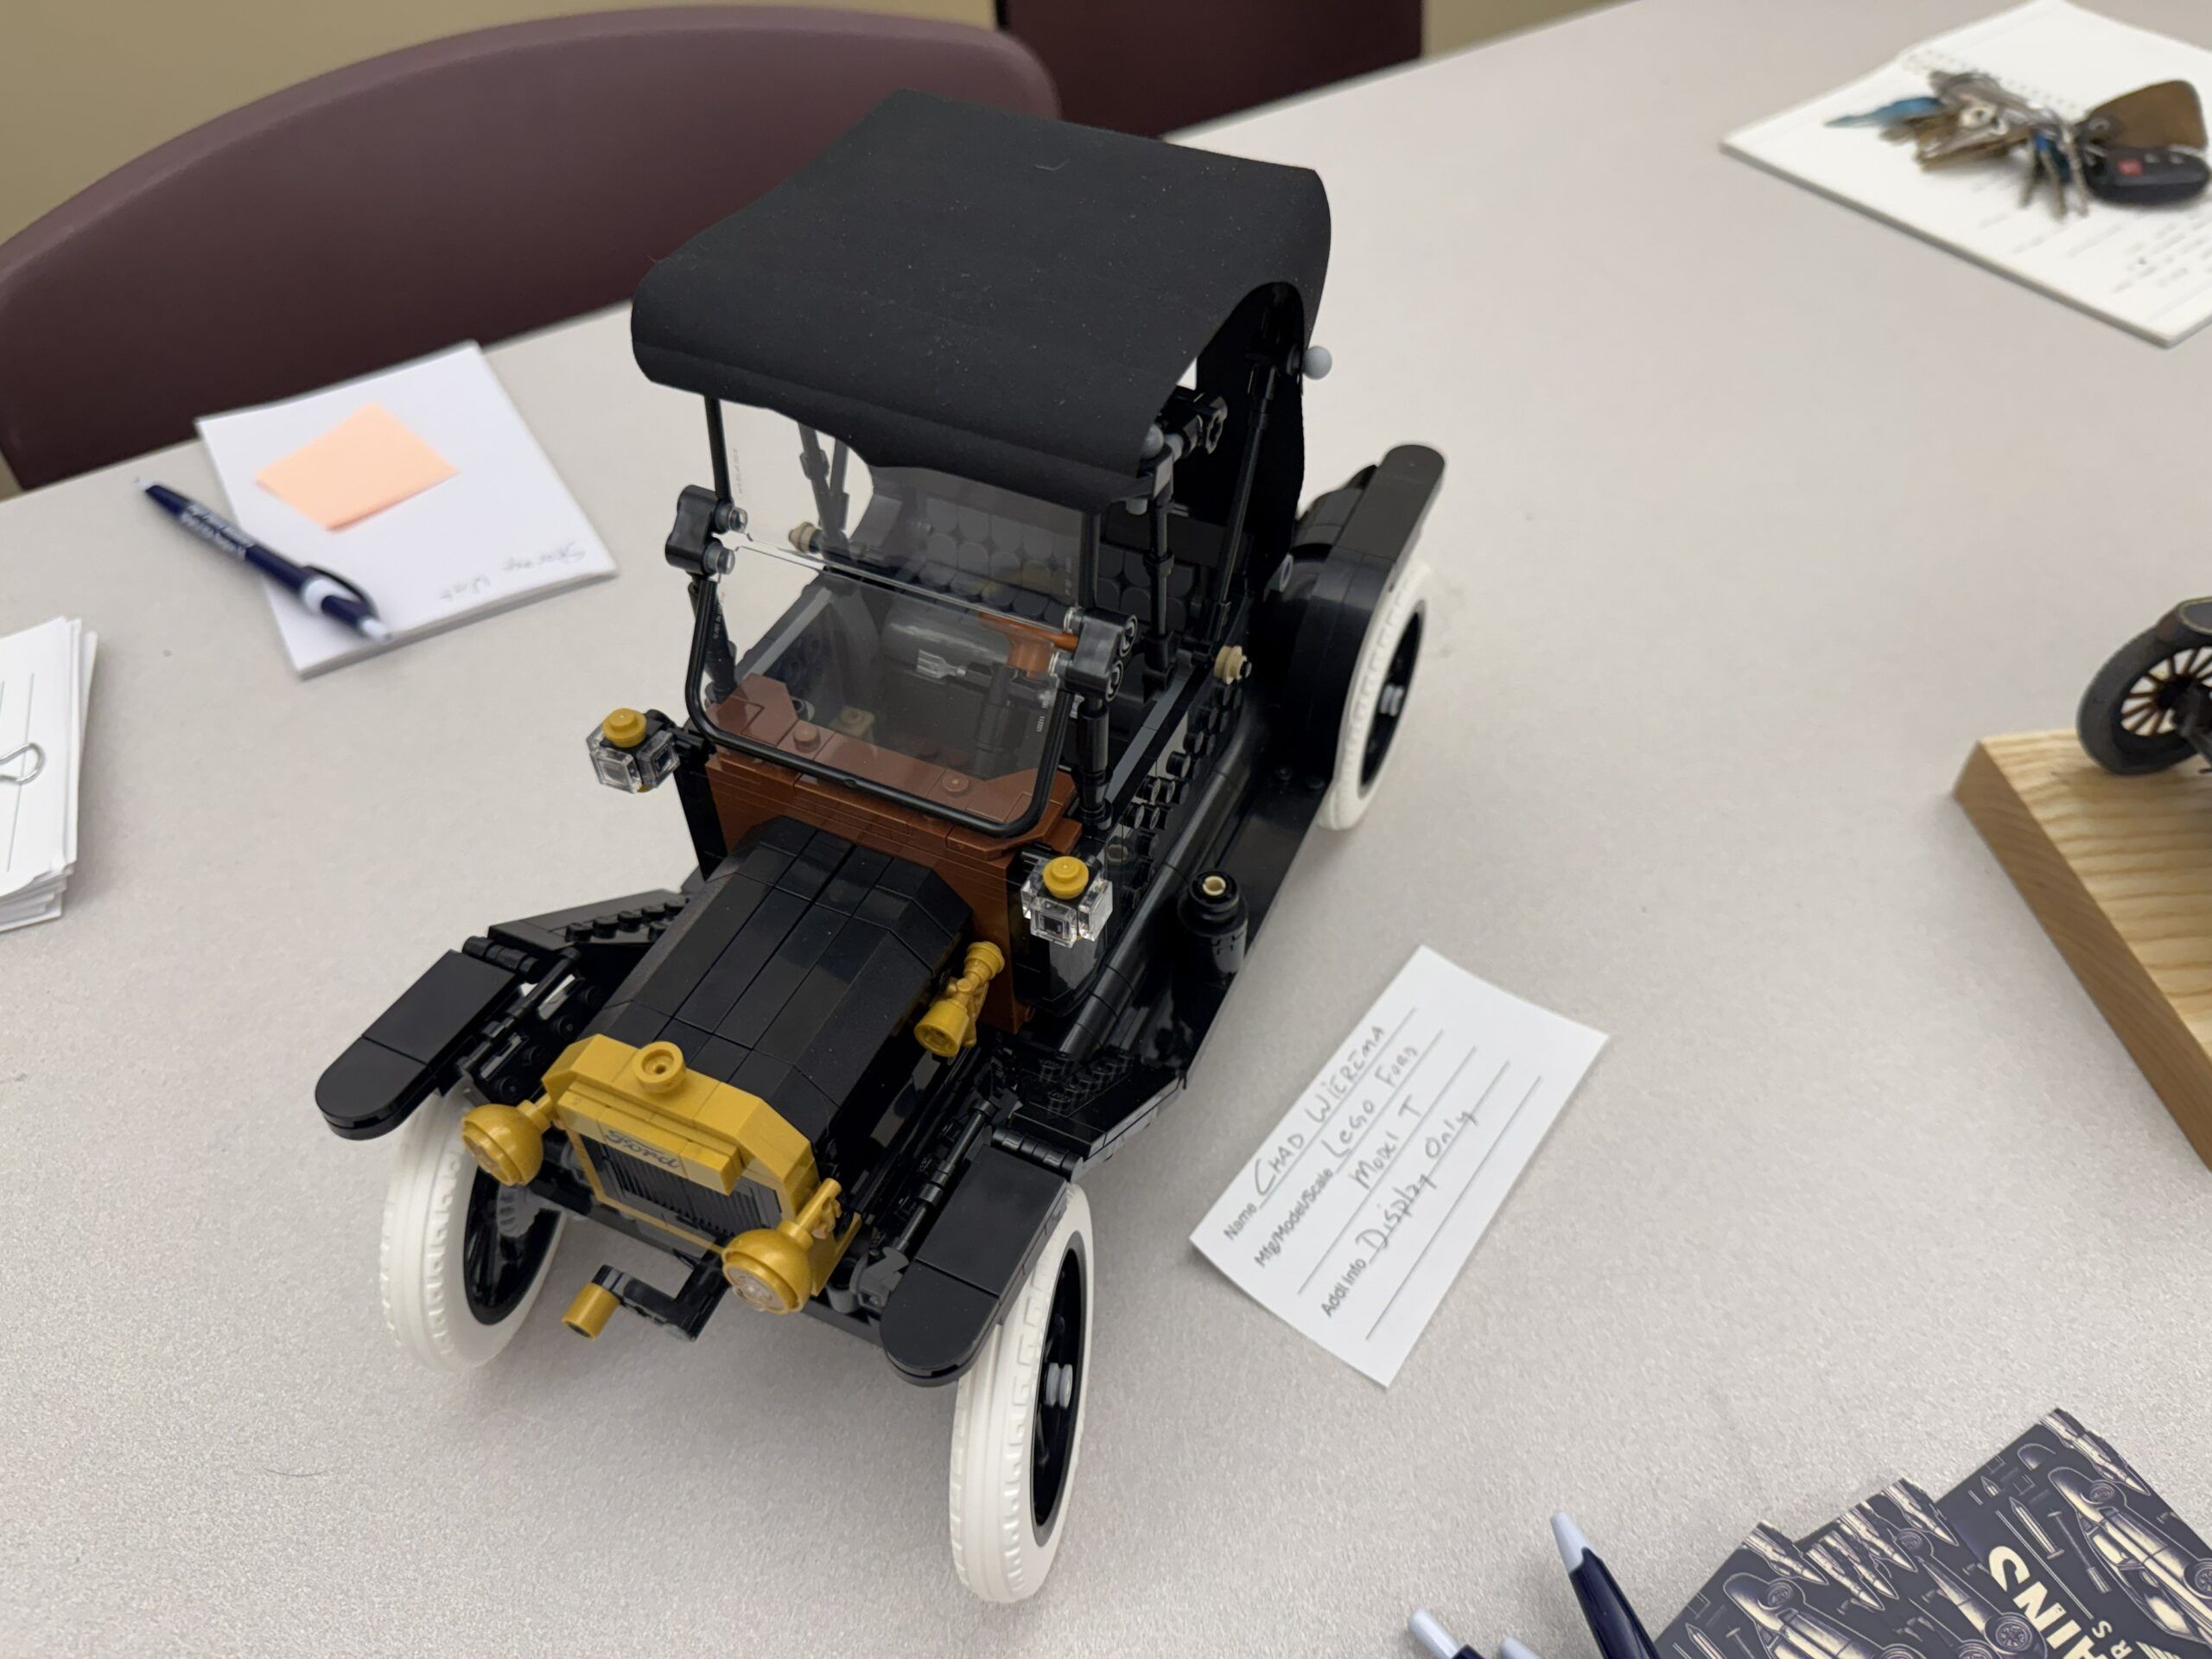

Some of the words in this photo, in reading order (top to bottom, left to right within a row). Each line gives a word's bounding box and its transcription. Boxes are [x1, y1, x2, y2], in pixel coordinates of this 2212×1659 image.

[1398, 1094, 1421, 1116] T
[605, 1129, 680, 1167] Ford
[1255, 1134, 1304, 1196] CHAD
[1355, 1173, 1437, 1249] Display
[1425, 1110, 1478, 1160] Only
[1223, 1202, 1256, 1241] Name
[1254, 1167, 1333, 1268] Mfg/Model/Scale
